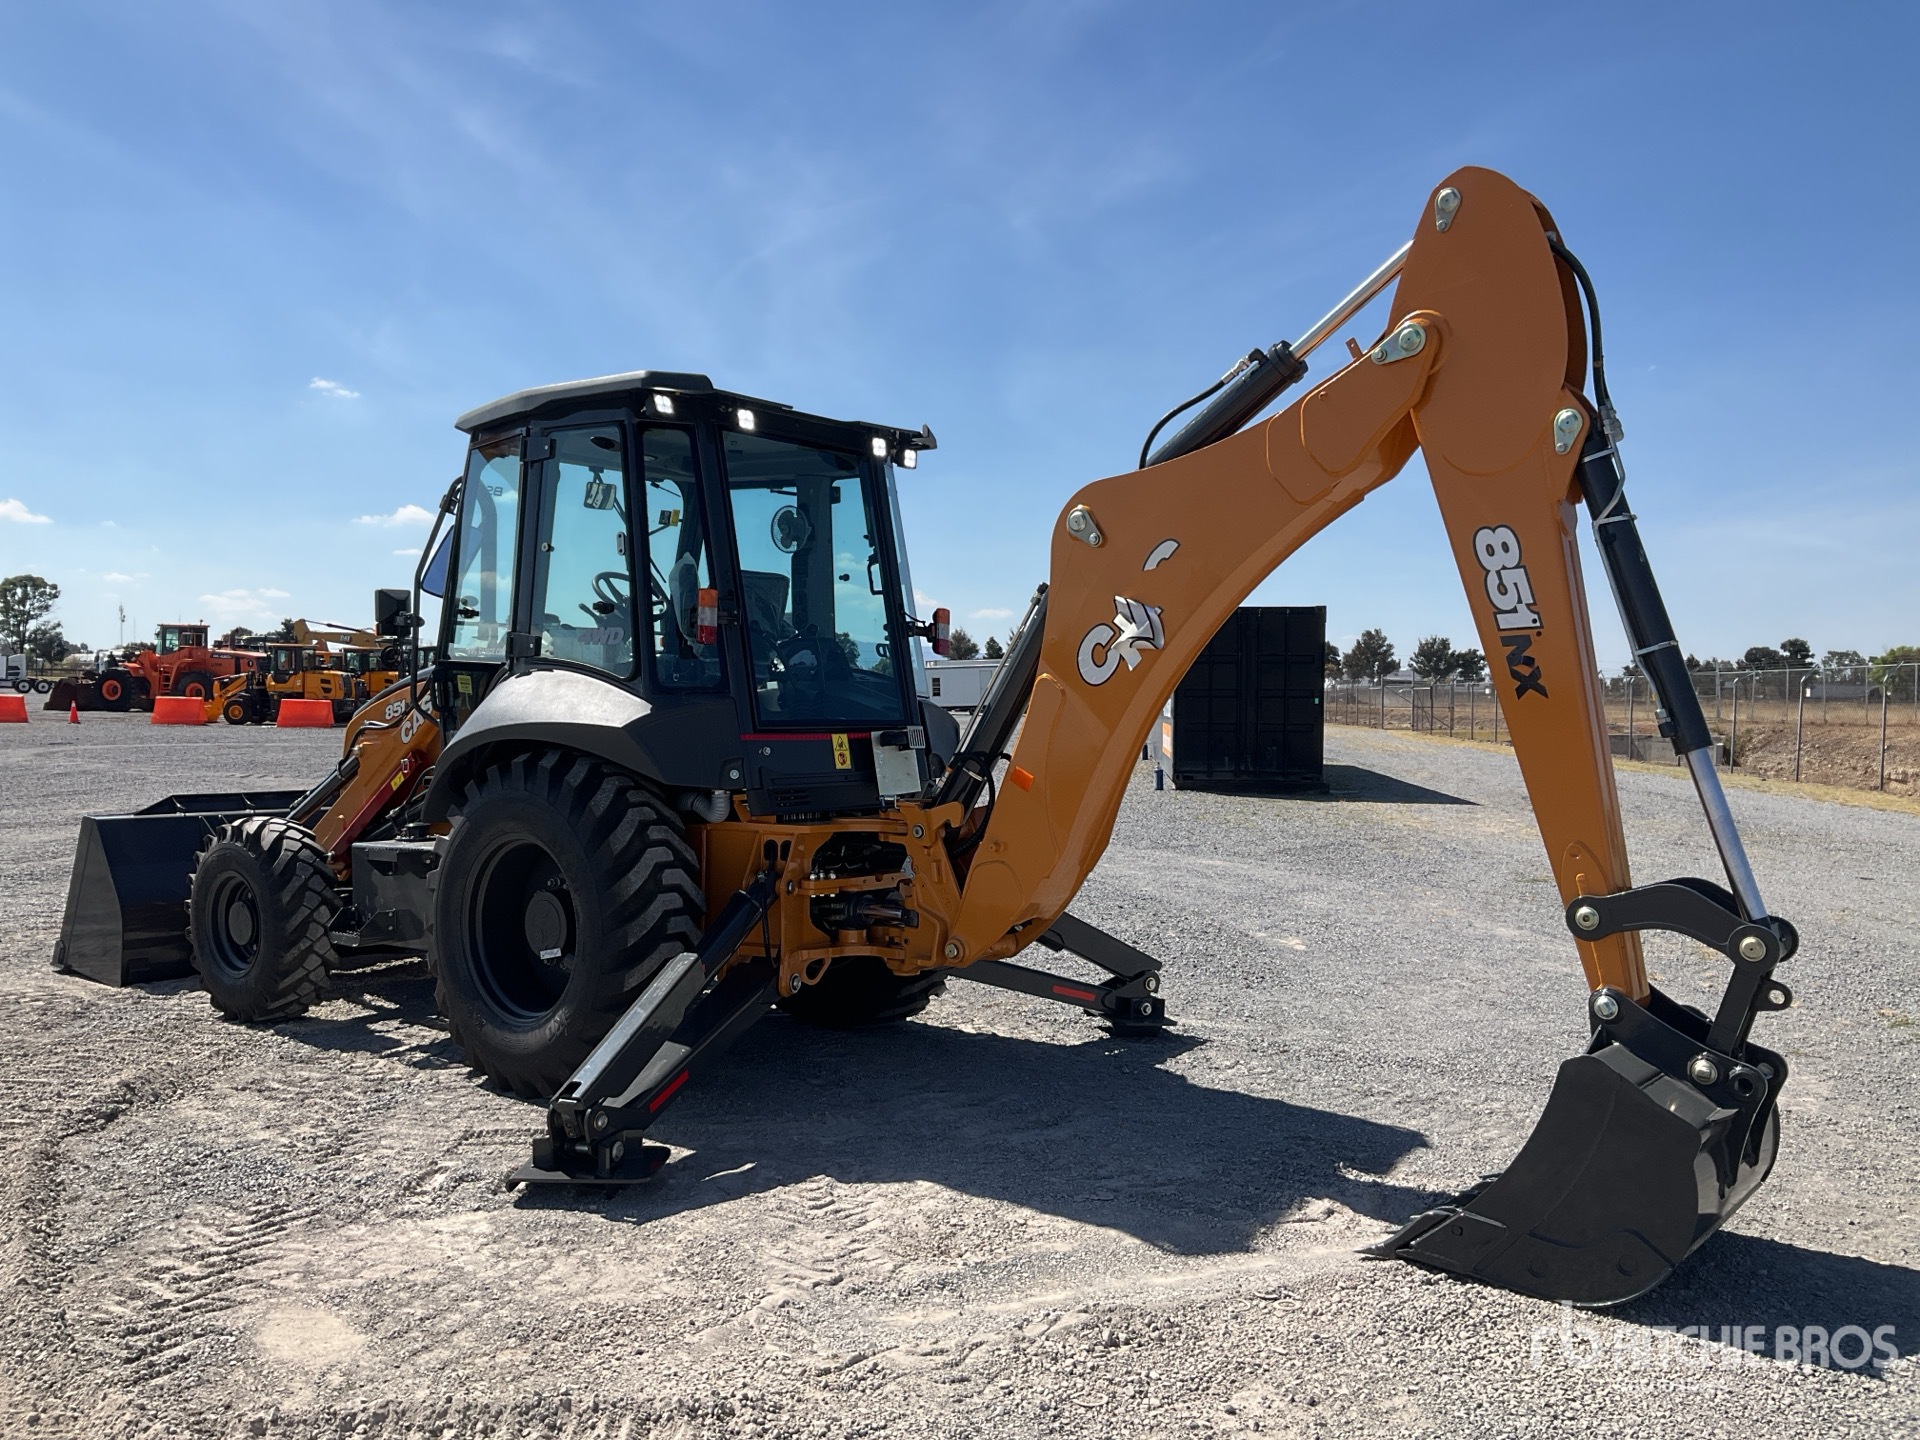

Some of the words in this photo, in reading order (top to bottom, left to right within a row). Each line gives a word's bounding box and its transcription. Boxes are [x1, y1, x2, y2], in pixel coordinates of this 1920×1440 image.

[1473, 524, 1544, 632] 851
[577, 626, 625, 646] 4WD
[384, 698, 406, 720] 851
[400, 693, 434, 744] CAS
